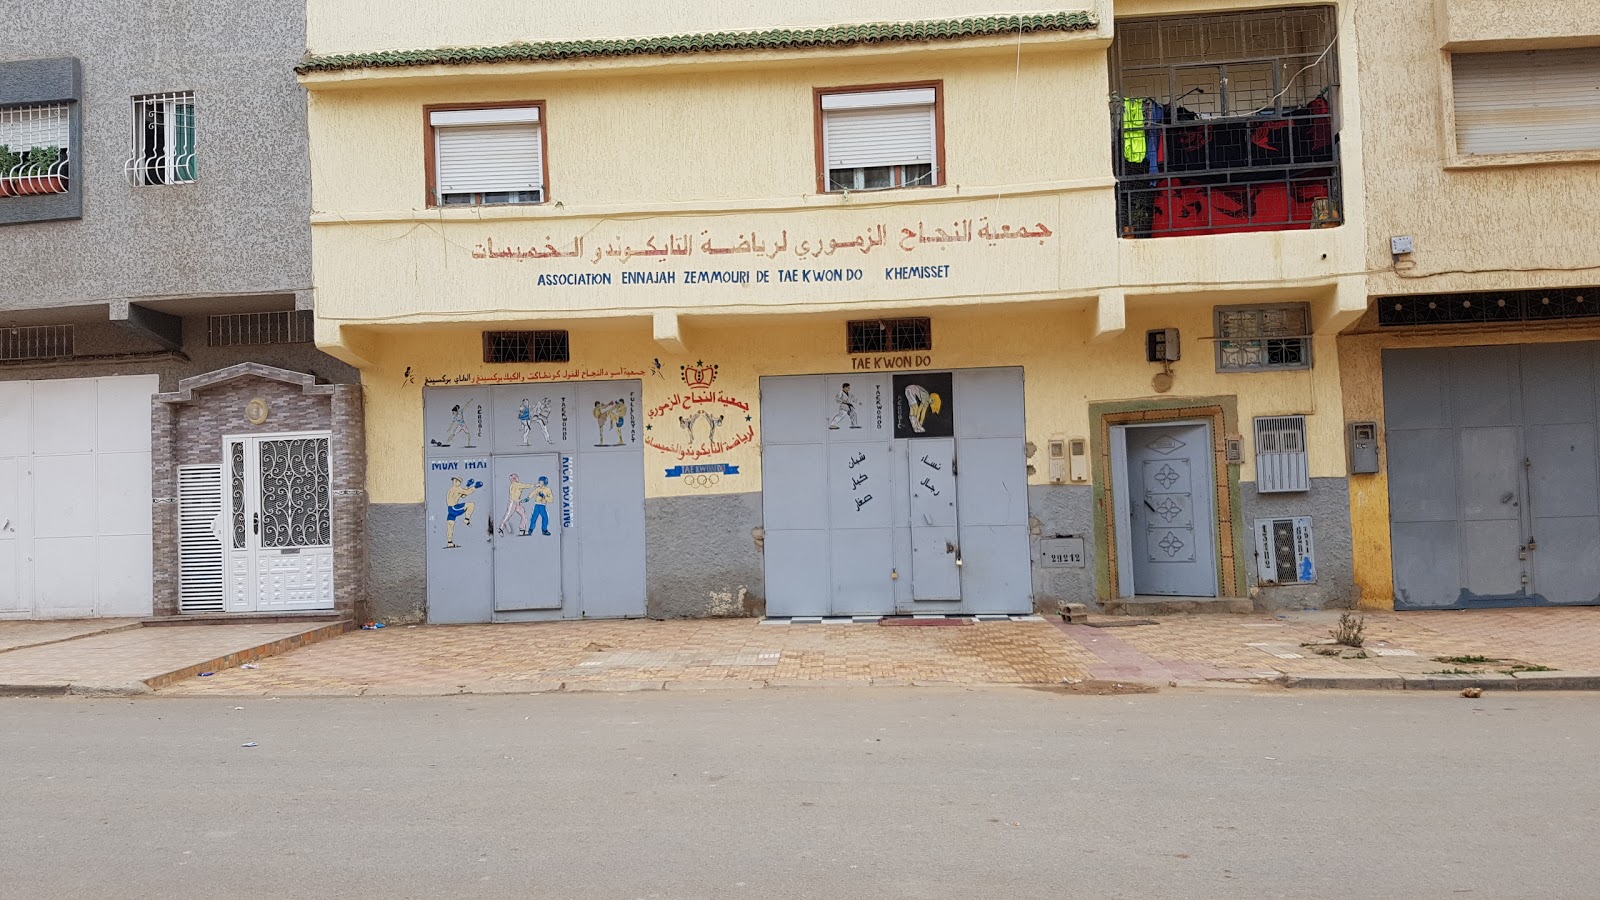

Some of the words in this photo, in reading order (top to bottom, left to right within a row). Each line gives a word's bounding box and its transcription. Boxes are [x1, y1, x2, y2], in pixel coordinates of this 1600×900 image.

[794, 223, 887, 261] الزموري
[899, 218, 973, 251] النجاح
[977, 216, 1053, 247] جمعية
[471, 235, 584, 263] الخميسات
[590, 233, 693, 265] التايكوندو
[700, 229, 788, 260] لرياضة
[537, 272, 612, 286] ASSOCIATION
[621, 271, 676, 285] ENNAJAH
[684, 270, 750, 284] ZEMMOURI
[756, 270, 770, 283] DE
[778, 269, 798, 283] TAE
[846, 268, 863, 282] DO
[885, 264, 950, 281] KHEMISSET
[581, 368, 604, 379] النجاح
[623, 367, 646, 377] جمعية
[851, 357, 871, 370] TAE
[915, 355, 931, 367] DO
[647, 393, 681, 419] الزموري
[682, 391, 717, 410] النجاح
[717, 390, 750, 413] جمعية
[725, 425, 754, 451] لرياضة
[431, 460, 459, 471] MUAY
[464, 458, 487, 470] THAI
[562, 456, 573, 483] KICK
[852, 473, 869, 491] كبار
[920, 477, 940, 496] رجال
[562, 485, 574, 528] BOXING
[1051, 553, 1080, 563] 29212
